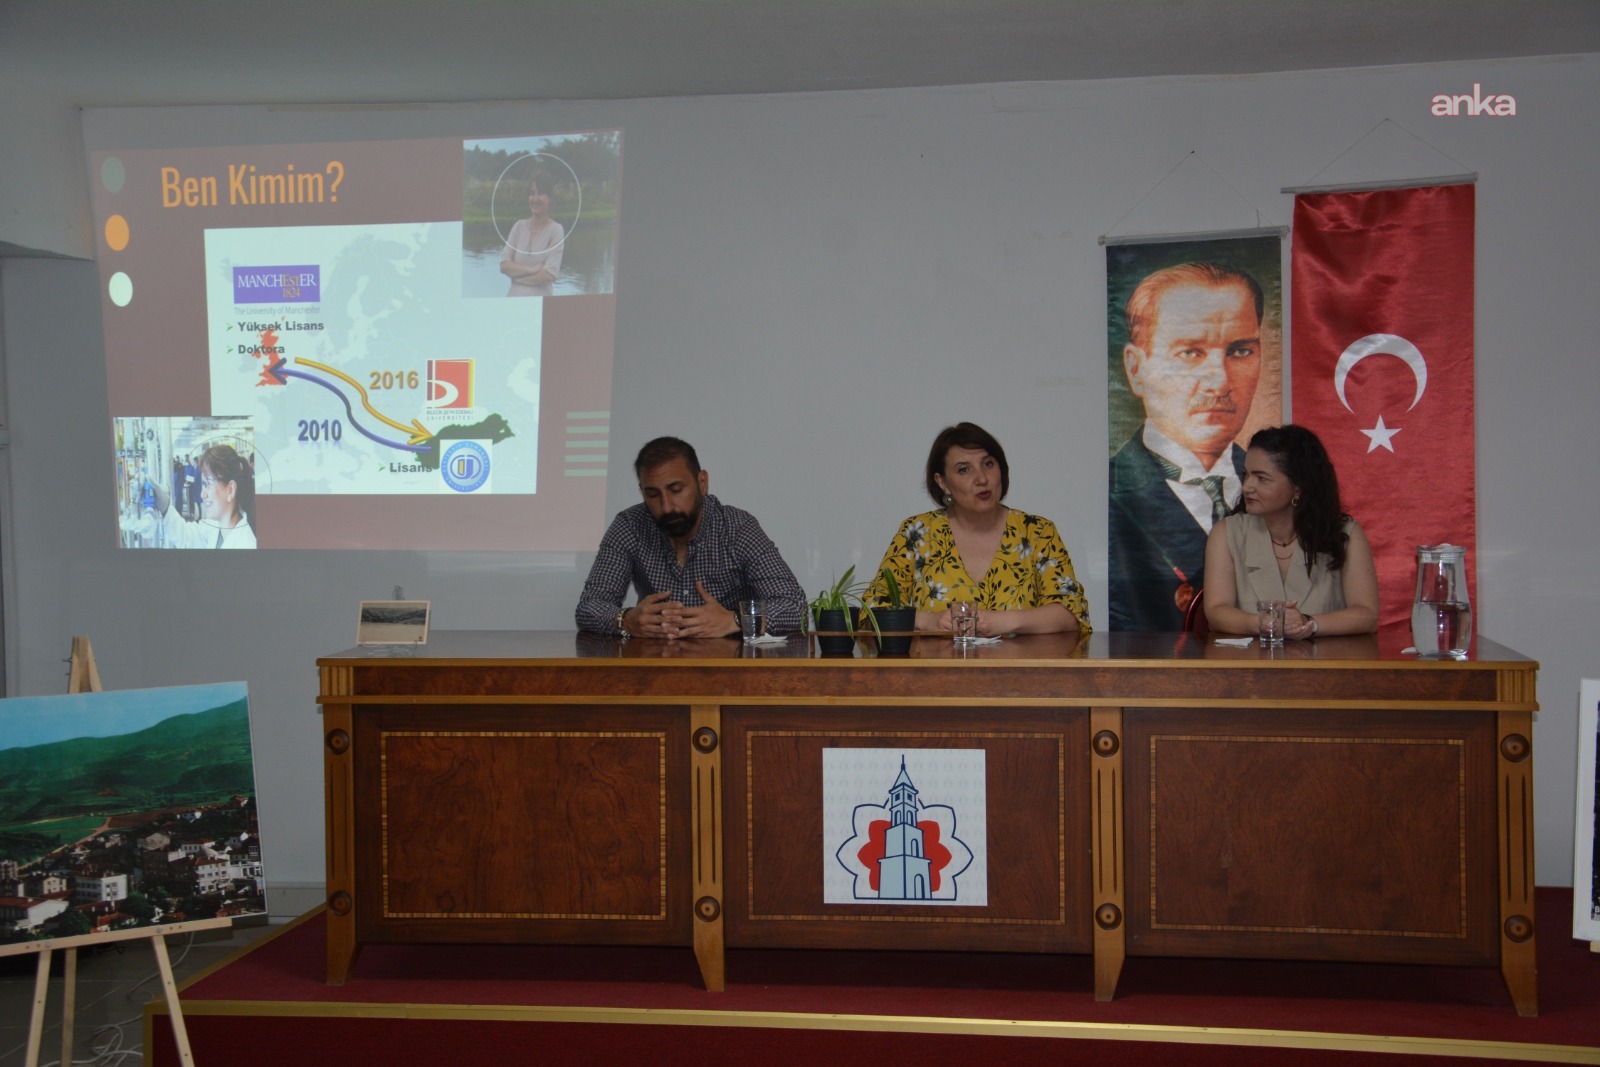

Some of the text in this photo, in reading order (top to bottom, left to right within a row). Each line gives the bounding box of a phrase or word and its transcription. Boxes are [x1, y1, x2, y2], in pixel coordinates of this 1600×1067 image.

[161, 160, 345, 208] Ben Kimim?
[238, 273, 317, 288] MANCHESTER
[282, 287, 301, 299] 1824
[234, 306, 246, 315] The
[247, 306, 276, 317] University
[285, 305, 321, 315] Manchester
[238, 320, 325, 332] Yüksek Lisans
[238, 344, 286, 354] Doktora
[369, 370, 420, 390] 2016
[298, 419, 342, 442] 2010
[389, 462, 433, 473] Lisans
